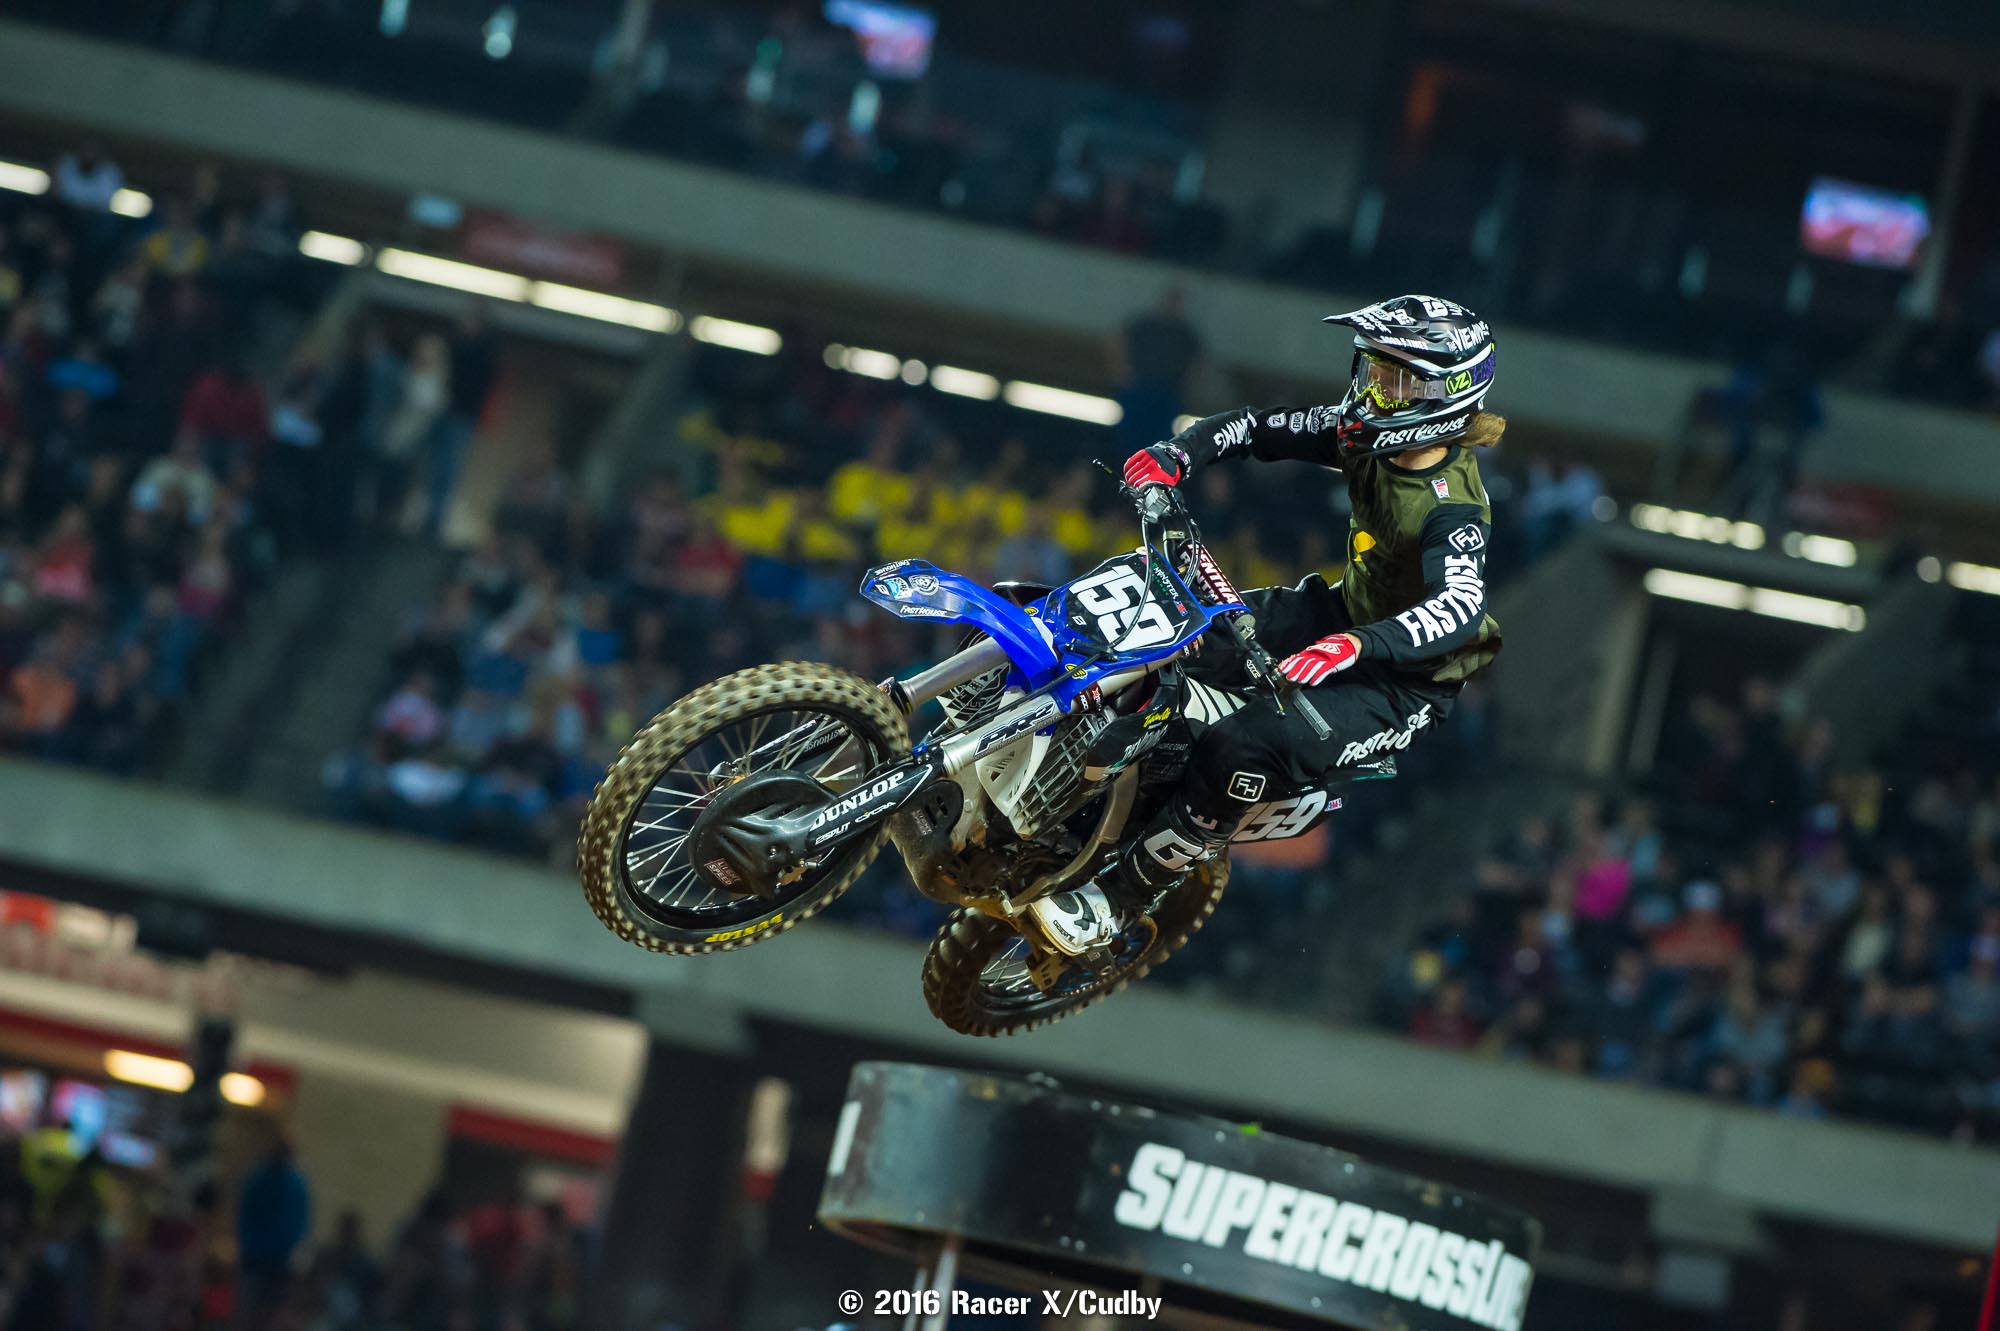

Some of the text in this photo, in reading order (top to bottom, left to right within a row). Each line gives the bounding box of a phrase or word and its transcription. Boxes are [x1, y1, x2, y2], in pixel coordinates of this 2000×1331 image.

[1372, 413, 1470, 449] FASTHOUSE
[900, 605, 947, 617] FASTHOUSE
[1069, 564, 1176, 652] 159
[810, 771, 904, 832] DUNLOP
